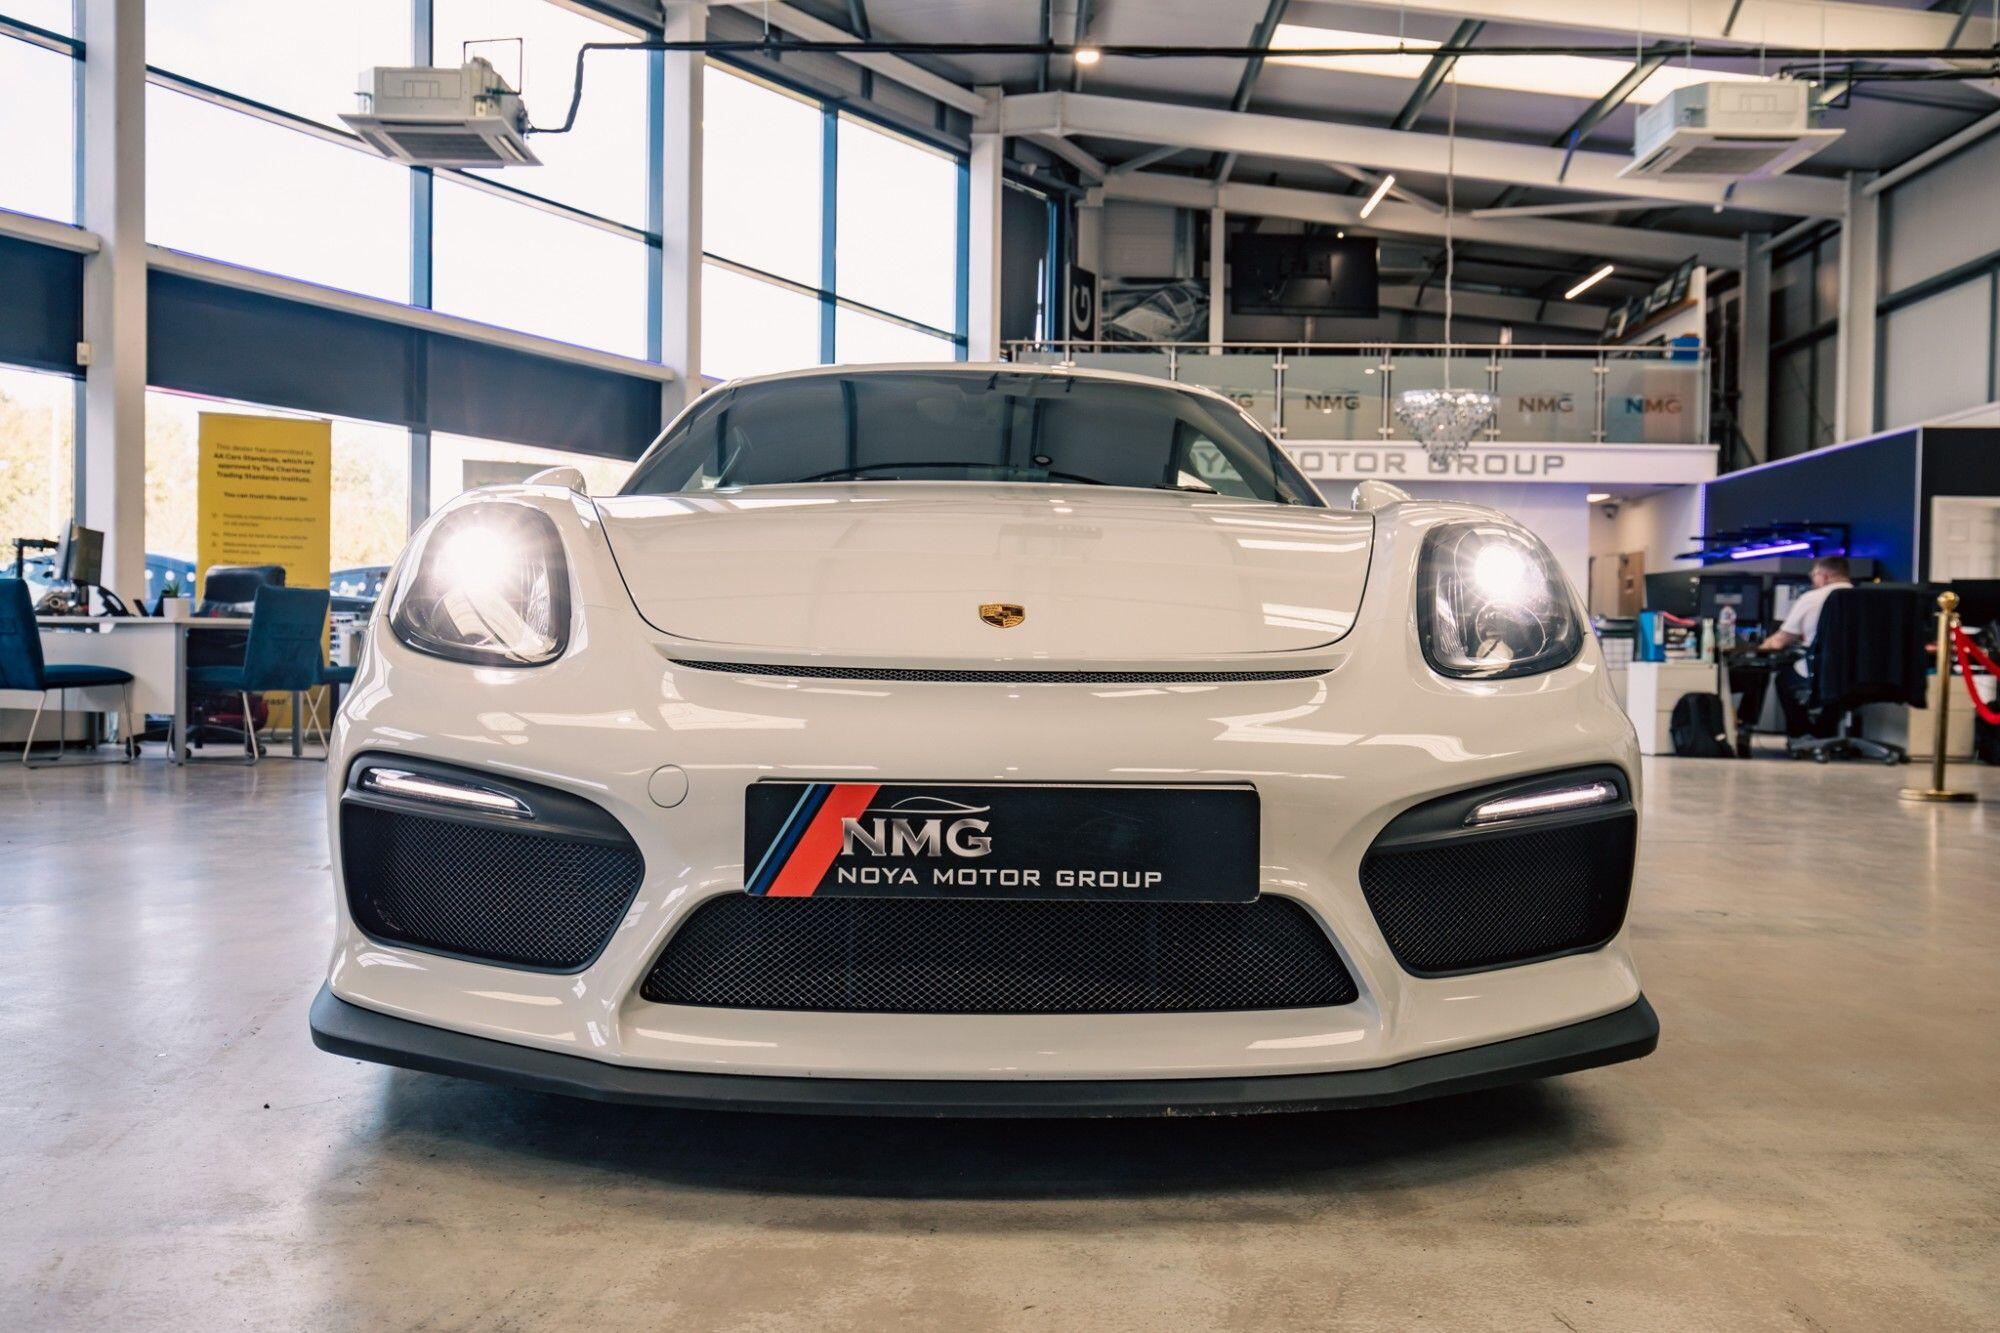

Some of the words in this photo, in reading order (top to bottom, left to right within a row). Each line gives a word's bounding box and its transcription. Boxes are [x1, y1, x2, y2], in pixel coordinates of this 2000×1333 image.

[1305, 395, 1359, 410] NMG
[1518, 398, 1574, 413] NMG
[1625, 399, 1683, 414] NMG
[1292, 452, 1406, 474] OTOR
[841, 817, 992, 858] NMG
[838, 867, 919, 885] NOYA
[933, 868, 1040, 886] MOTOR
[1056, 870, 1162, 888] GROUP
